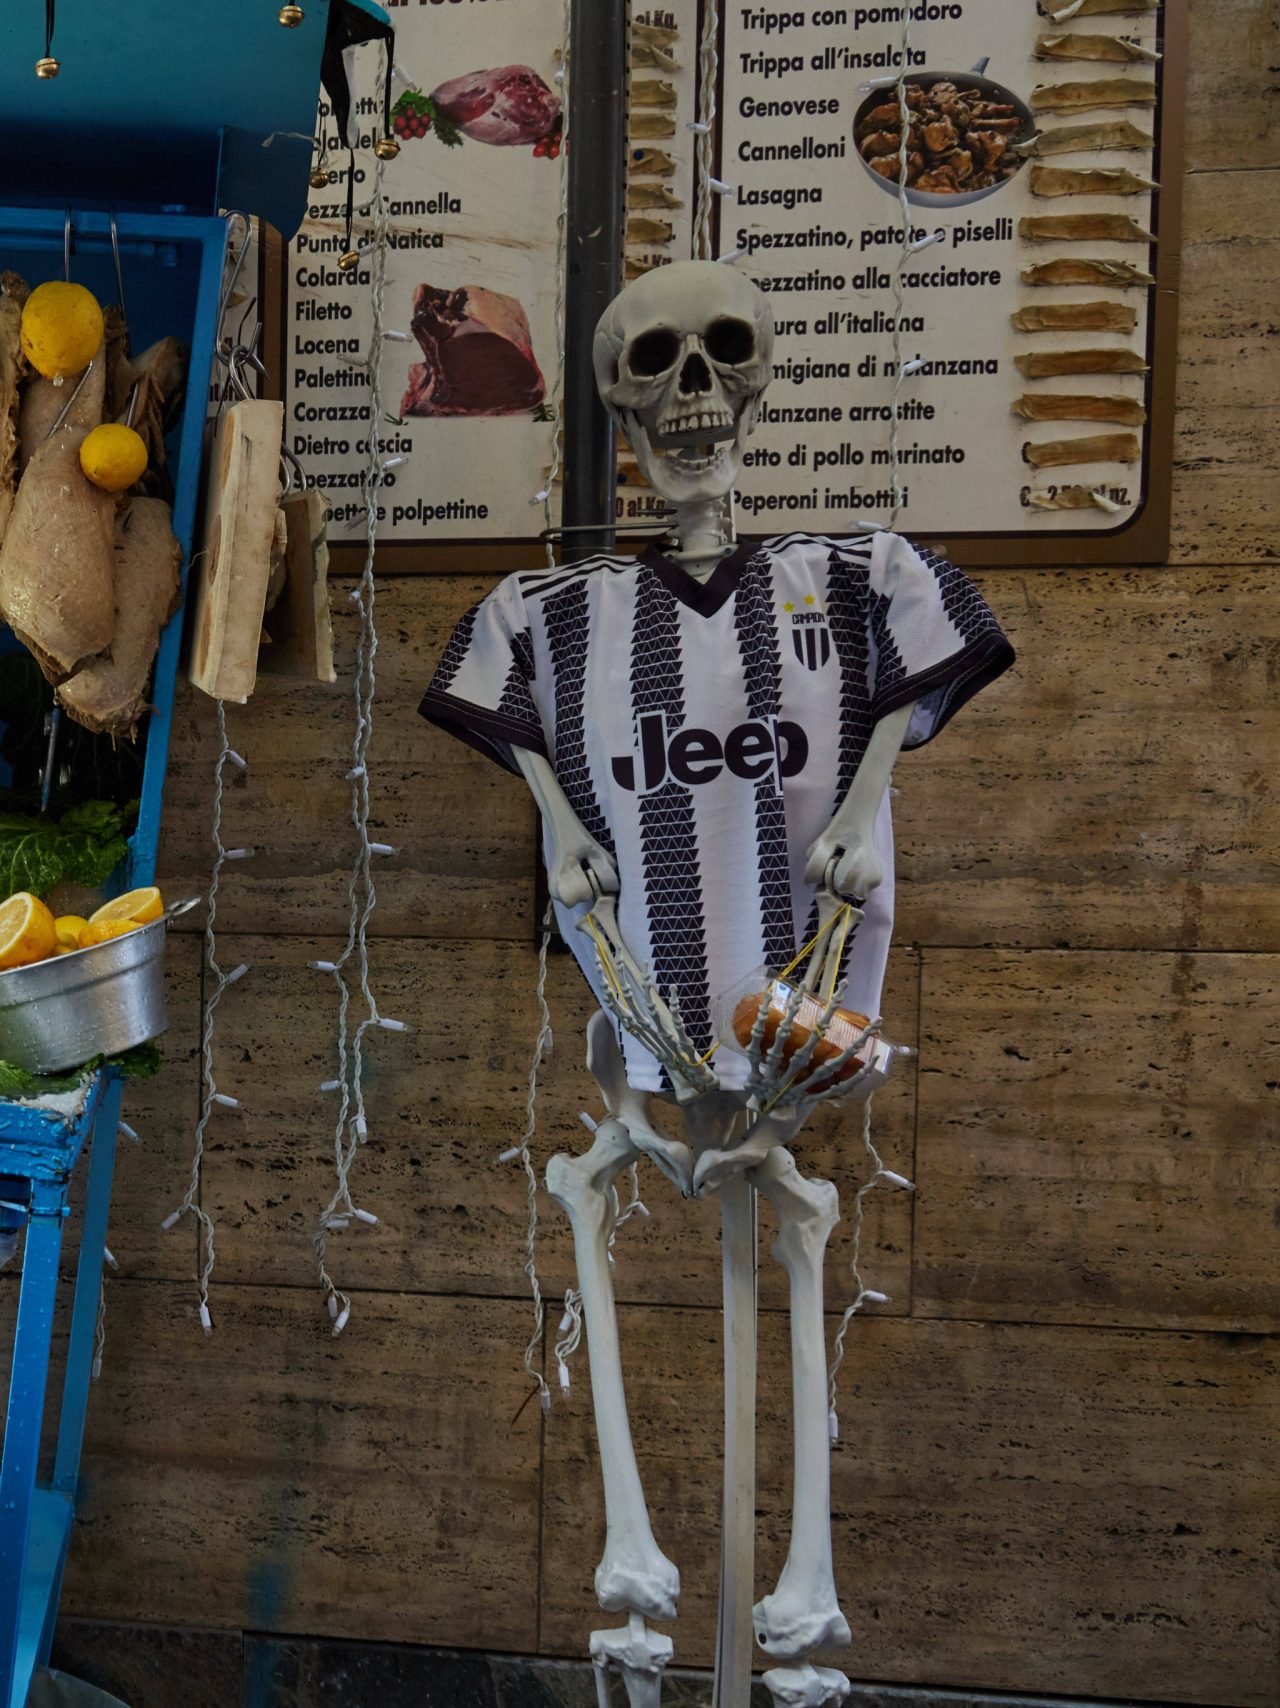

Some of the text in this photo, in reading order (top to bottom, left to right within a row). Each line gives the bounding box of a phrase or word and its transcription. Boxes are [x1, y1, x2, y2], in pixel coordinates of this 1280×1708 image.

[741, 0, 963, 34] Trippa con pomodoro
[740, 44, 926, 79] Trippa all'insalata
[739, 96, 840, 118] Genovese
[737, 136, 846, 162] Cannelloni
[379, 192, 462, 216] annella
[737, 185, 823, 210] Lasagna
[736, 225, 854, 255] Spezzatino,
[861, 225, 927, 252] patate
[953, 217, 1013, 249] piselli
[296, 265, 370, 287] Colarda
[750, 269, 846, 292] ezzatino
[852, 267, 891, 289] alla
[295, 299, 352, 321] Filetto
[814, 310, 925, 335] all'italiana
[295, 335, 360, 355] Locena
[858, 354, 877, 377] di
[884, 354, 998, 377] mlanzana
[293, 402, 371, 422] Corazza
[294, 434, 350, 455] Dietro
[743, 448, 781, 467] etto
[788, 444, 807, 466] di
[813, 442, 864, 471] pollo
[825, 486, 909, 509] imbottii
[393, 498, 489, 526] polpettine
[610, 710, 810, 798] Jeep
